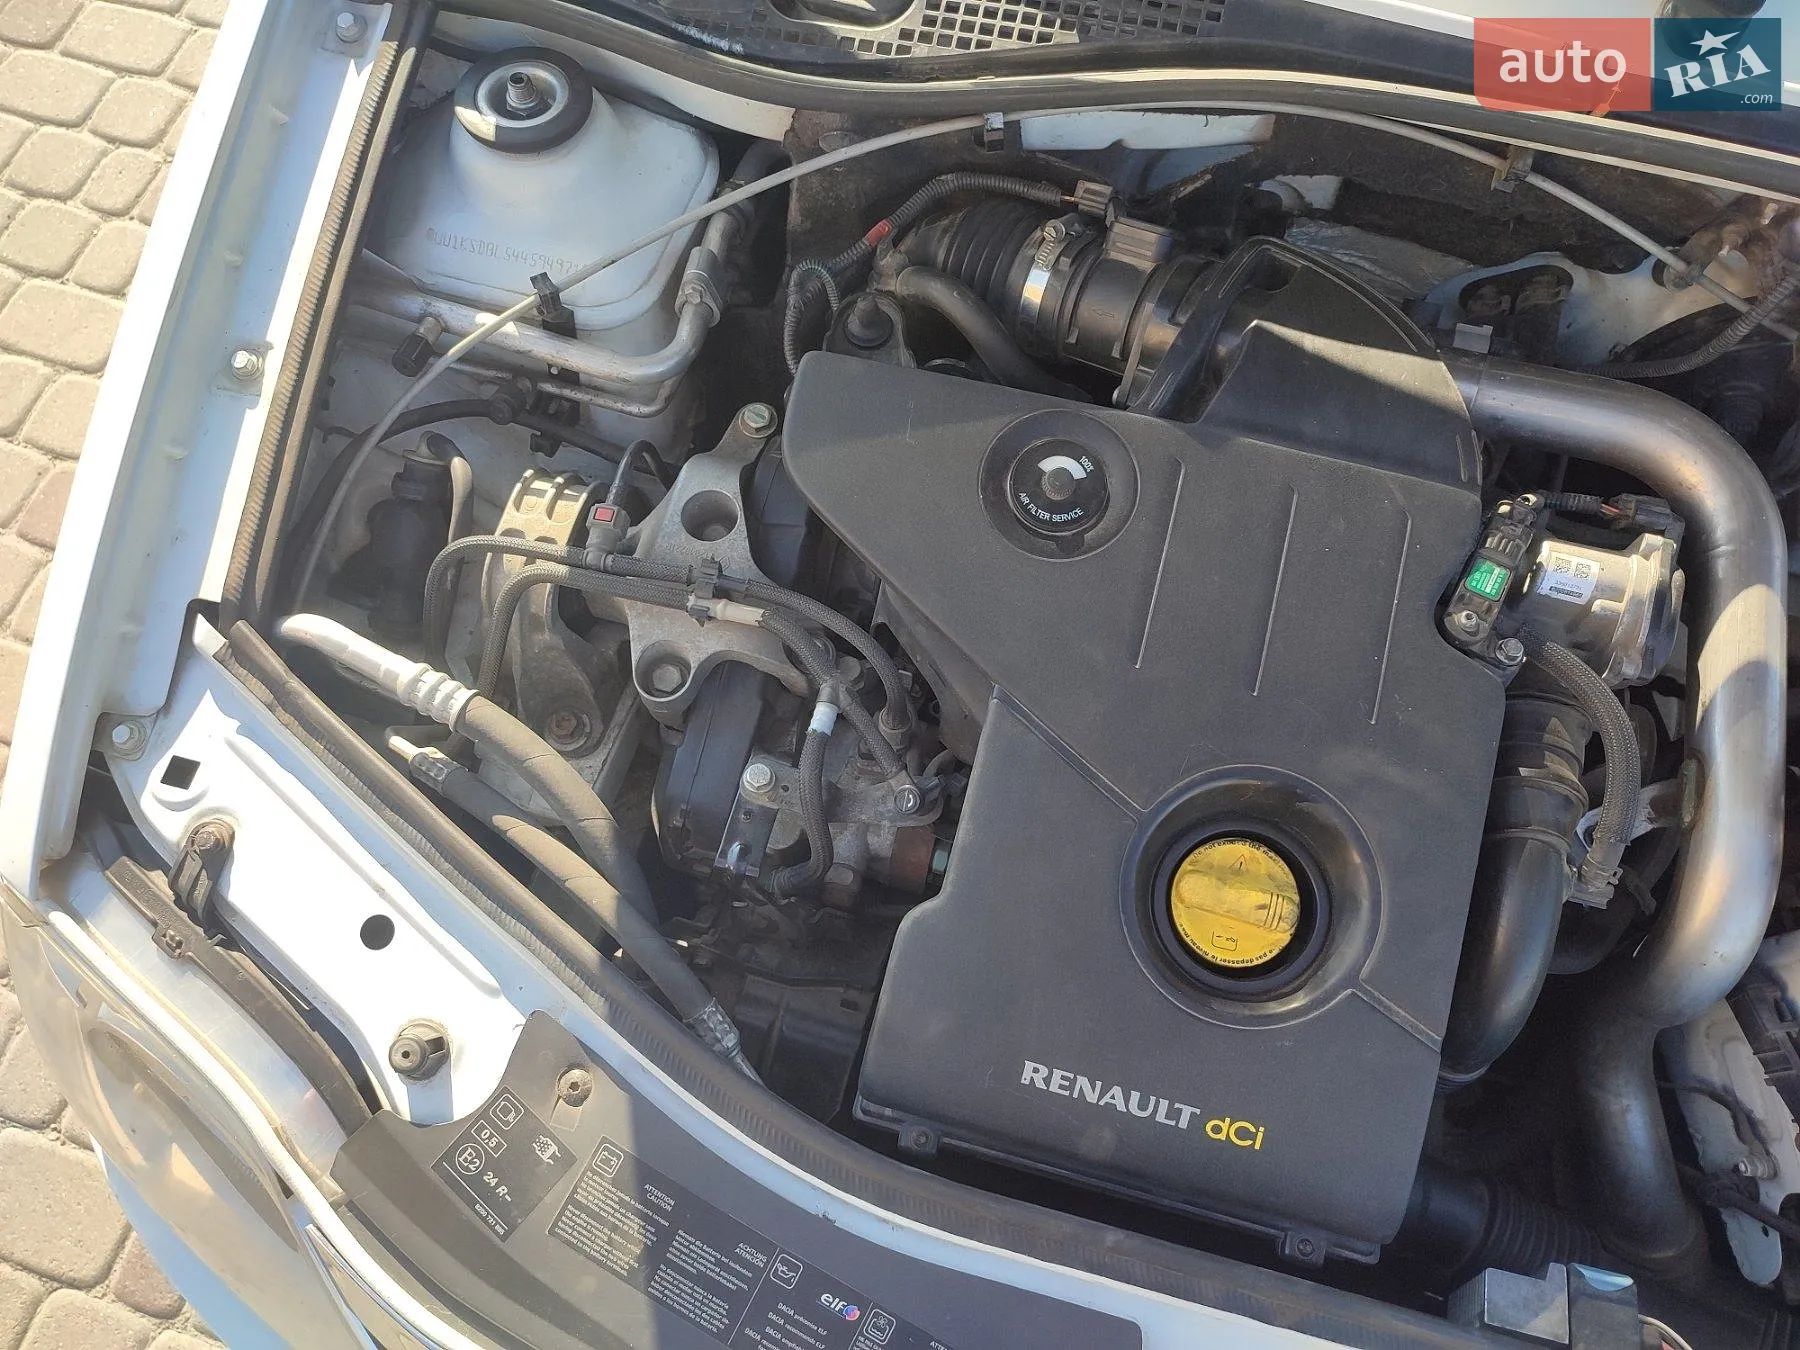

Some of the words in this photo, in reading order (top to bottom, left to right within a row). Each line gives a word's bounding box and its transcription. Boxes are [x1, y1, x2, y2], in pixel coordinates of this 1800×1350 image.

[1079, 455, 1094, 473] 100%
[1018, 492, 1030, 506] AIR
[1027, 503, 1051, 521] FILTER
[1051, 507, 1084, 522] SERVICE
[1020, 1060, 1201, 1130] RENAULT
[1205, 1117, 1265, 1150] dCi
[458, 1147, 483, 1172] E2
[482, 1170, 499, 1186] 24
[644, 1184, 674, 1205] ATTENTION
[646, 1193, 671, 1210] CAUTION
[739, 1242, 766, 1262] ACHTUNG
[820, 1291, 846, 1312] elf
